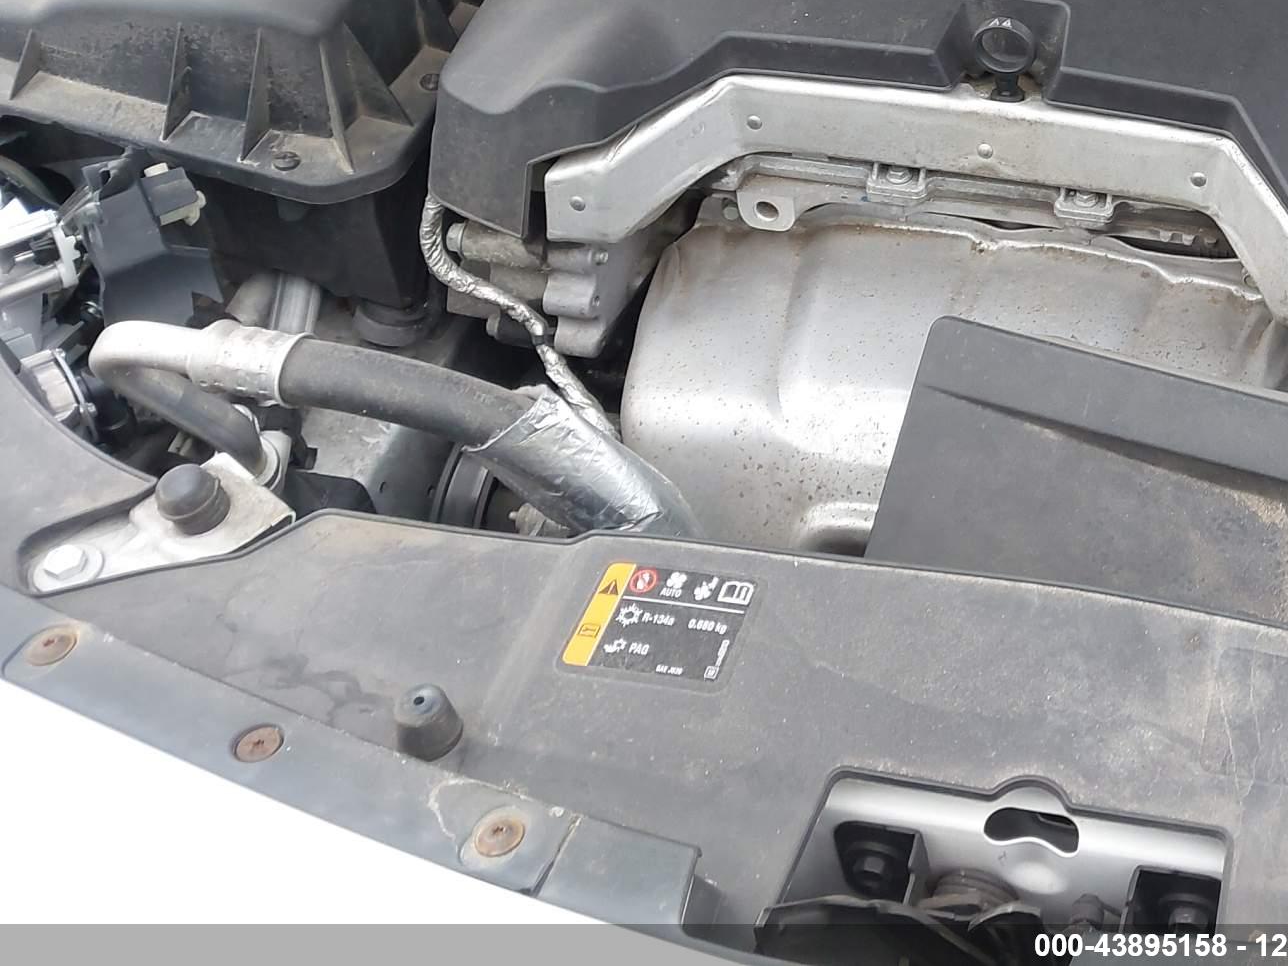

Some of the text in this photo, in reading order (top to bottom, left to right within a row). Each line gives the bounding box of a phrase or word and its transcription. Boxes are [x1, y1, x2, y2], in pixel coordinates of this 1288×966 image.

[660, 588, 682, 598] AUTO
[641, 612, 675, 626] R-134a
[714, 622, 728, 635] kg
